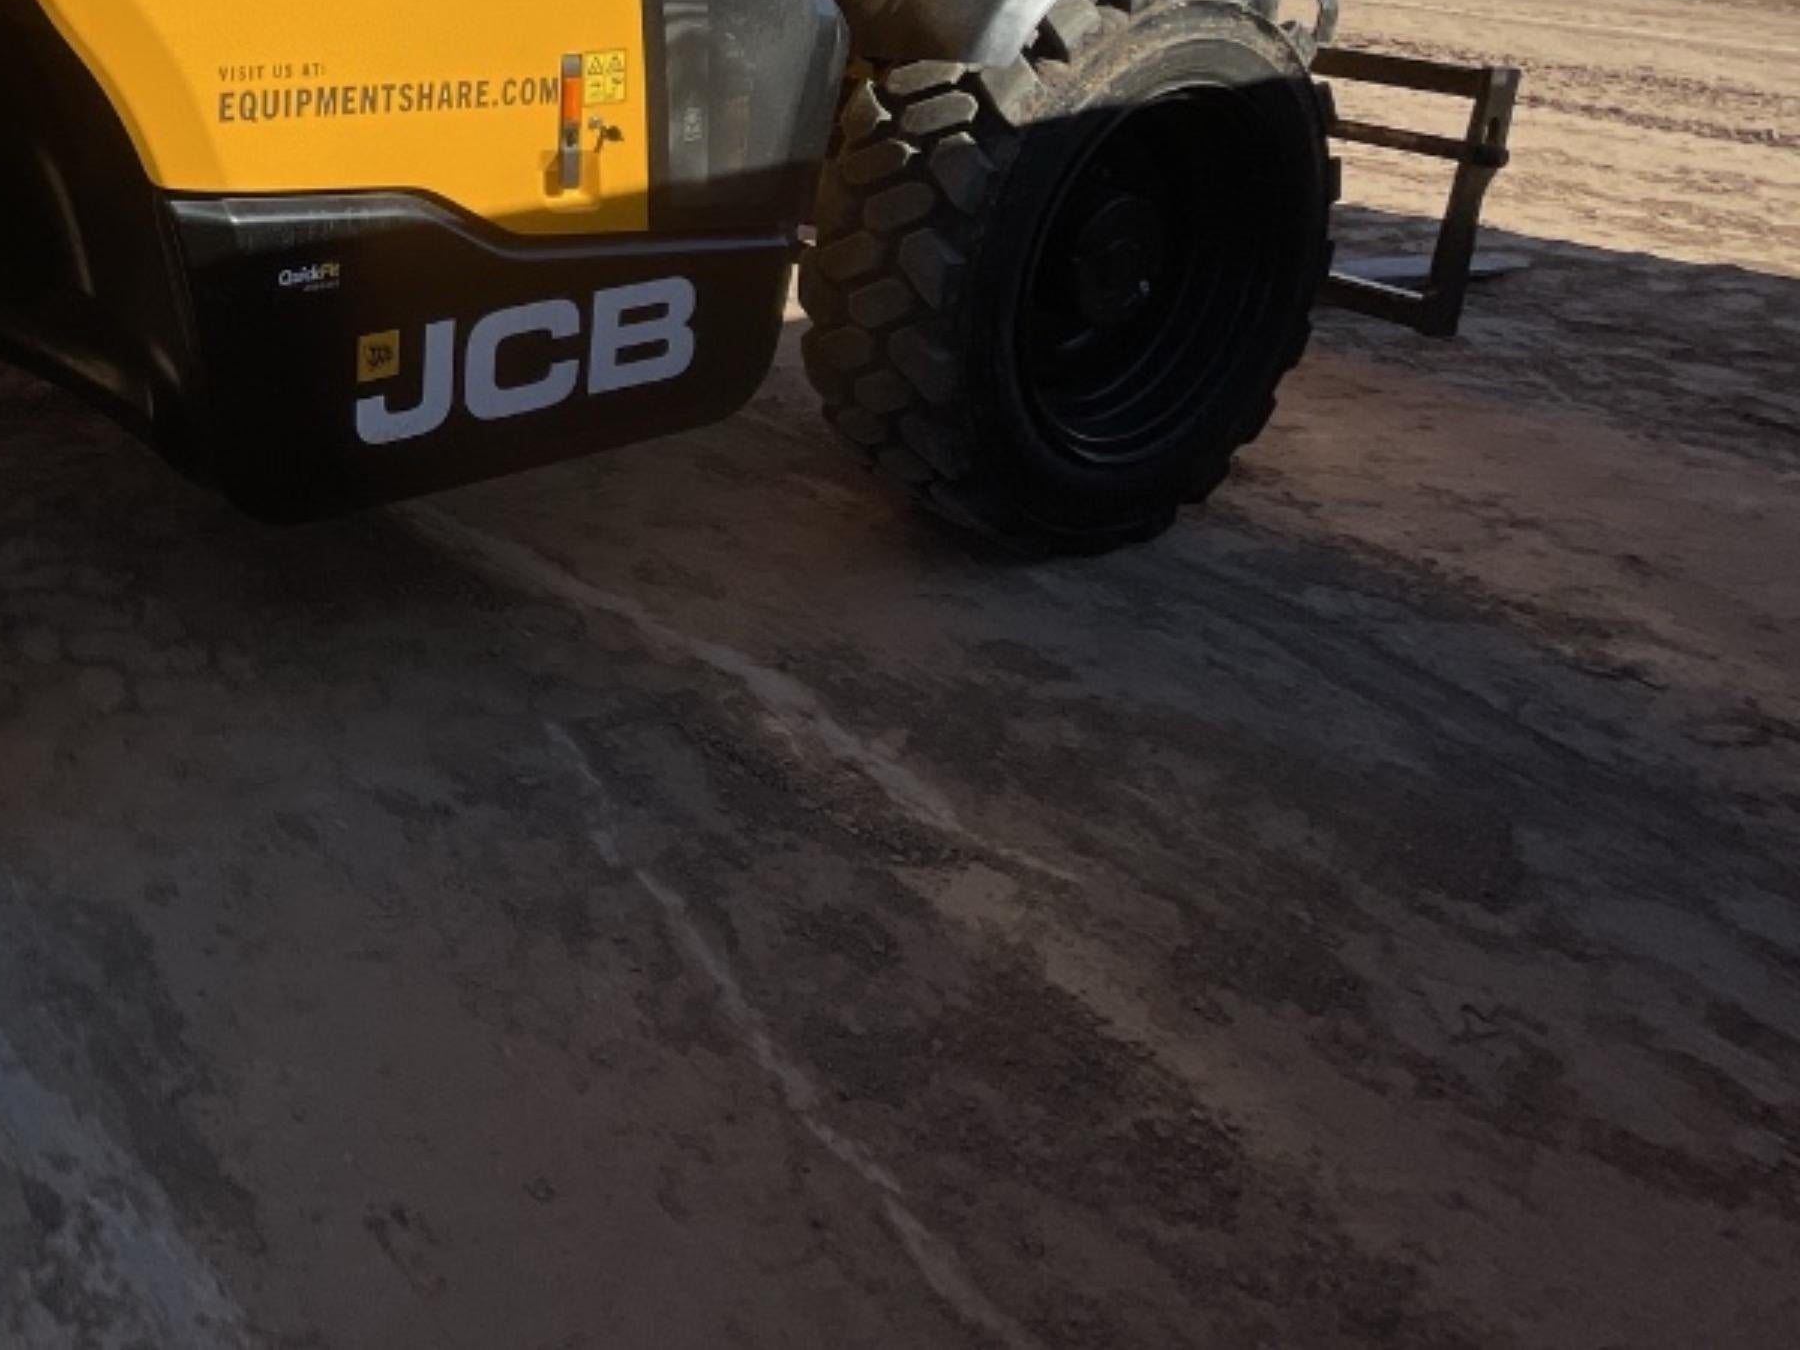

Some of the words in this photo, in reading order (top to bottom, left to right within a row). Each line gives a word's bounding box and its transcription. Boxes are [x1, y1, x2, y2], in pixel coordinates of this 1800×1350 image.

[218, 65, 265, 82] VISIT
[272, 63, 292, 79] US
[218, 76, 560, 123] EQUIPMENTSHARE.COM
[355, 276, 698, 445] JCB
